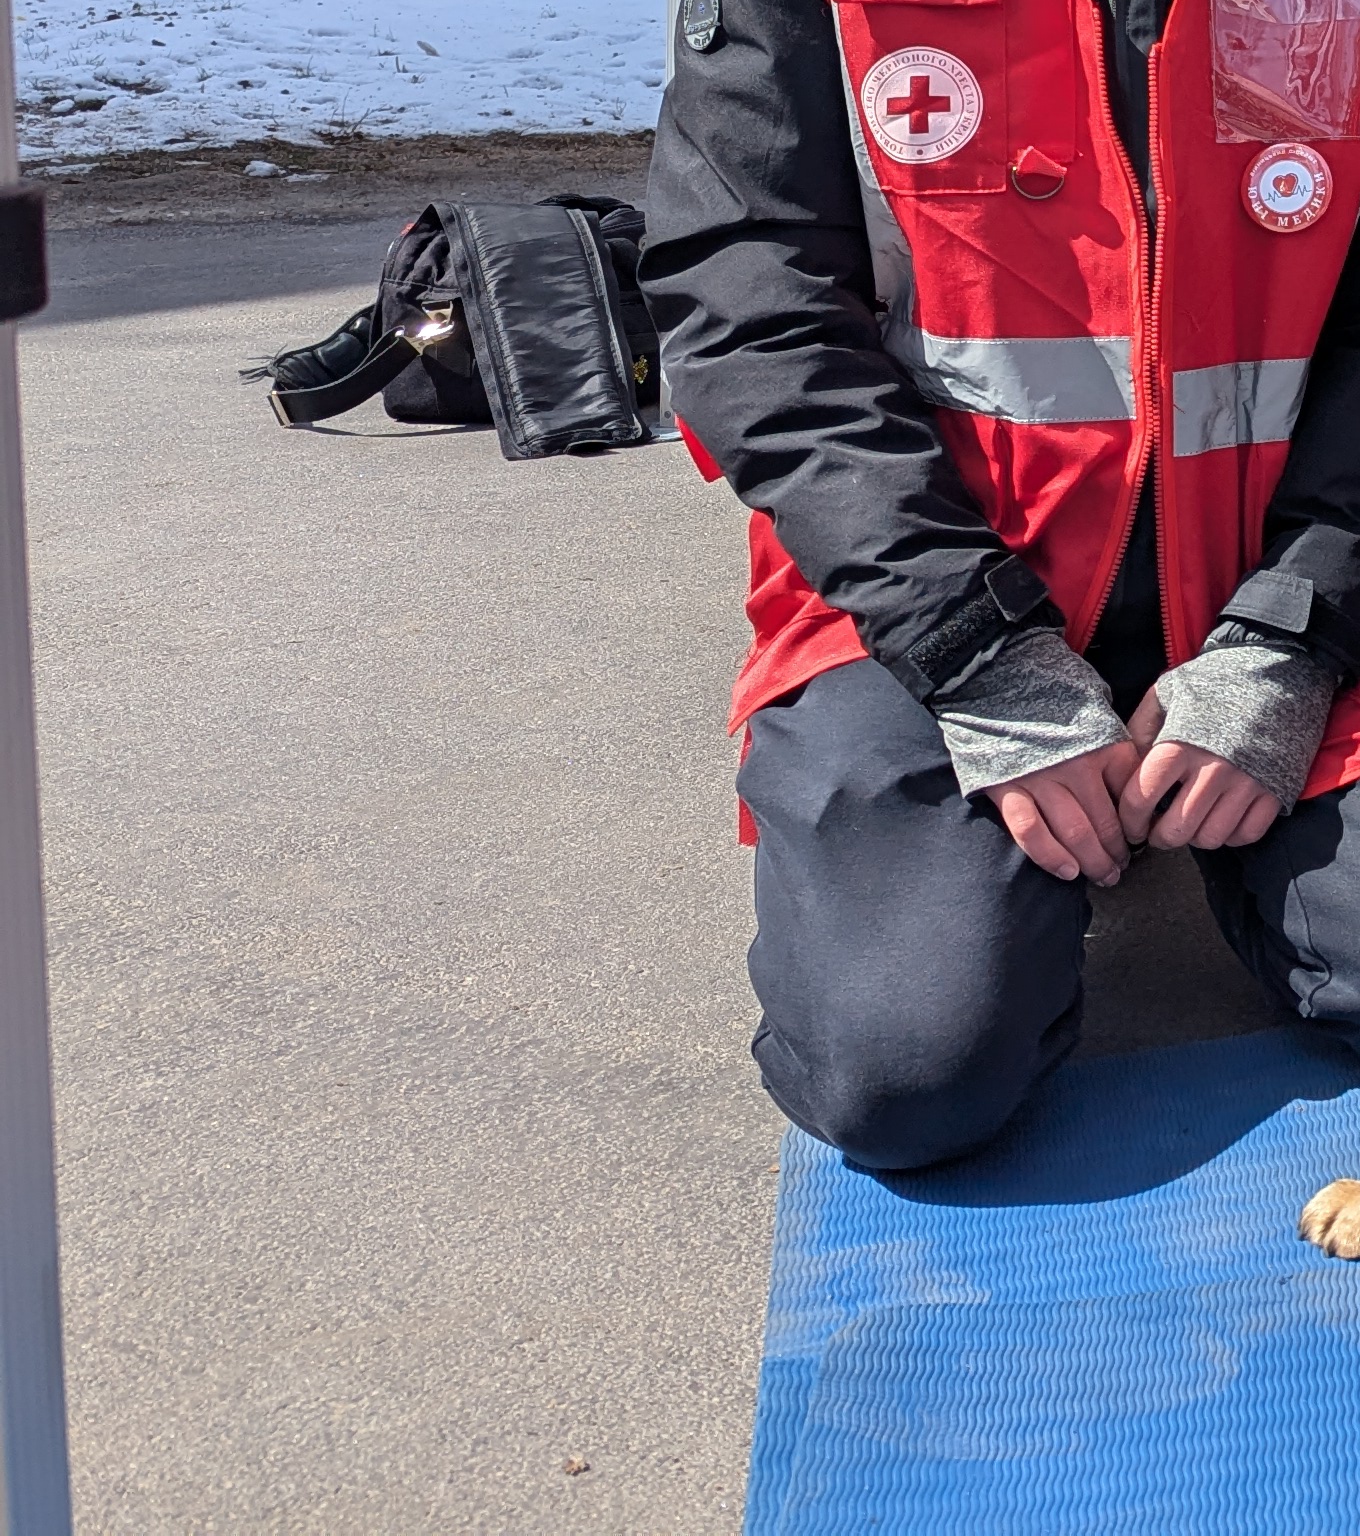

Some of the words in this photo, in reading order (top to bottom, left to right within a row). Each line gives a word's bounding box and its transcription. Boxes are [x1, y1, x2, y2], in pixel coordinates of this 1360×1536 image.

[871, 53, 948, 83] ЧЕРВОНОГО
[948, 64, 975, 105] ХРЕСТА
[865, 87, 904, 155] ТОВАРИСТВО
[935, 109, 975, 153] УКРАЇНИ
[1248, 185, 1269, 220] ЮНІ
[1277, 172, 1326, 227] МЕДИКИ
